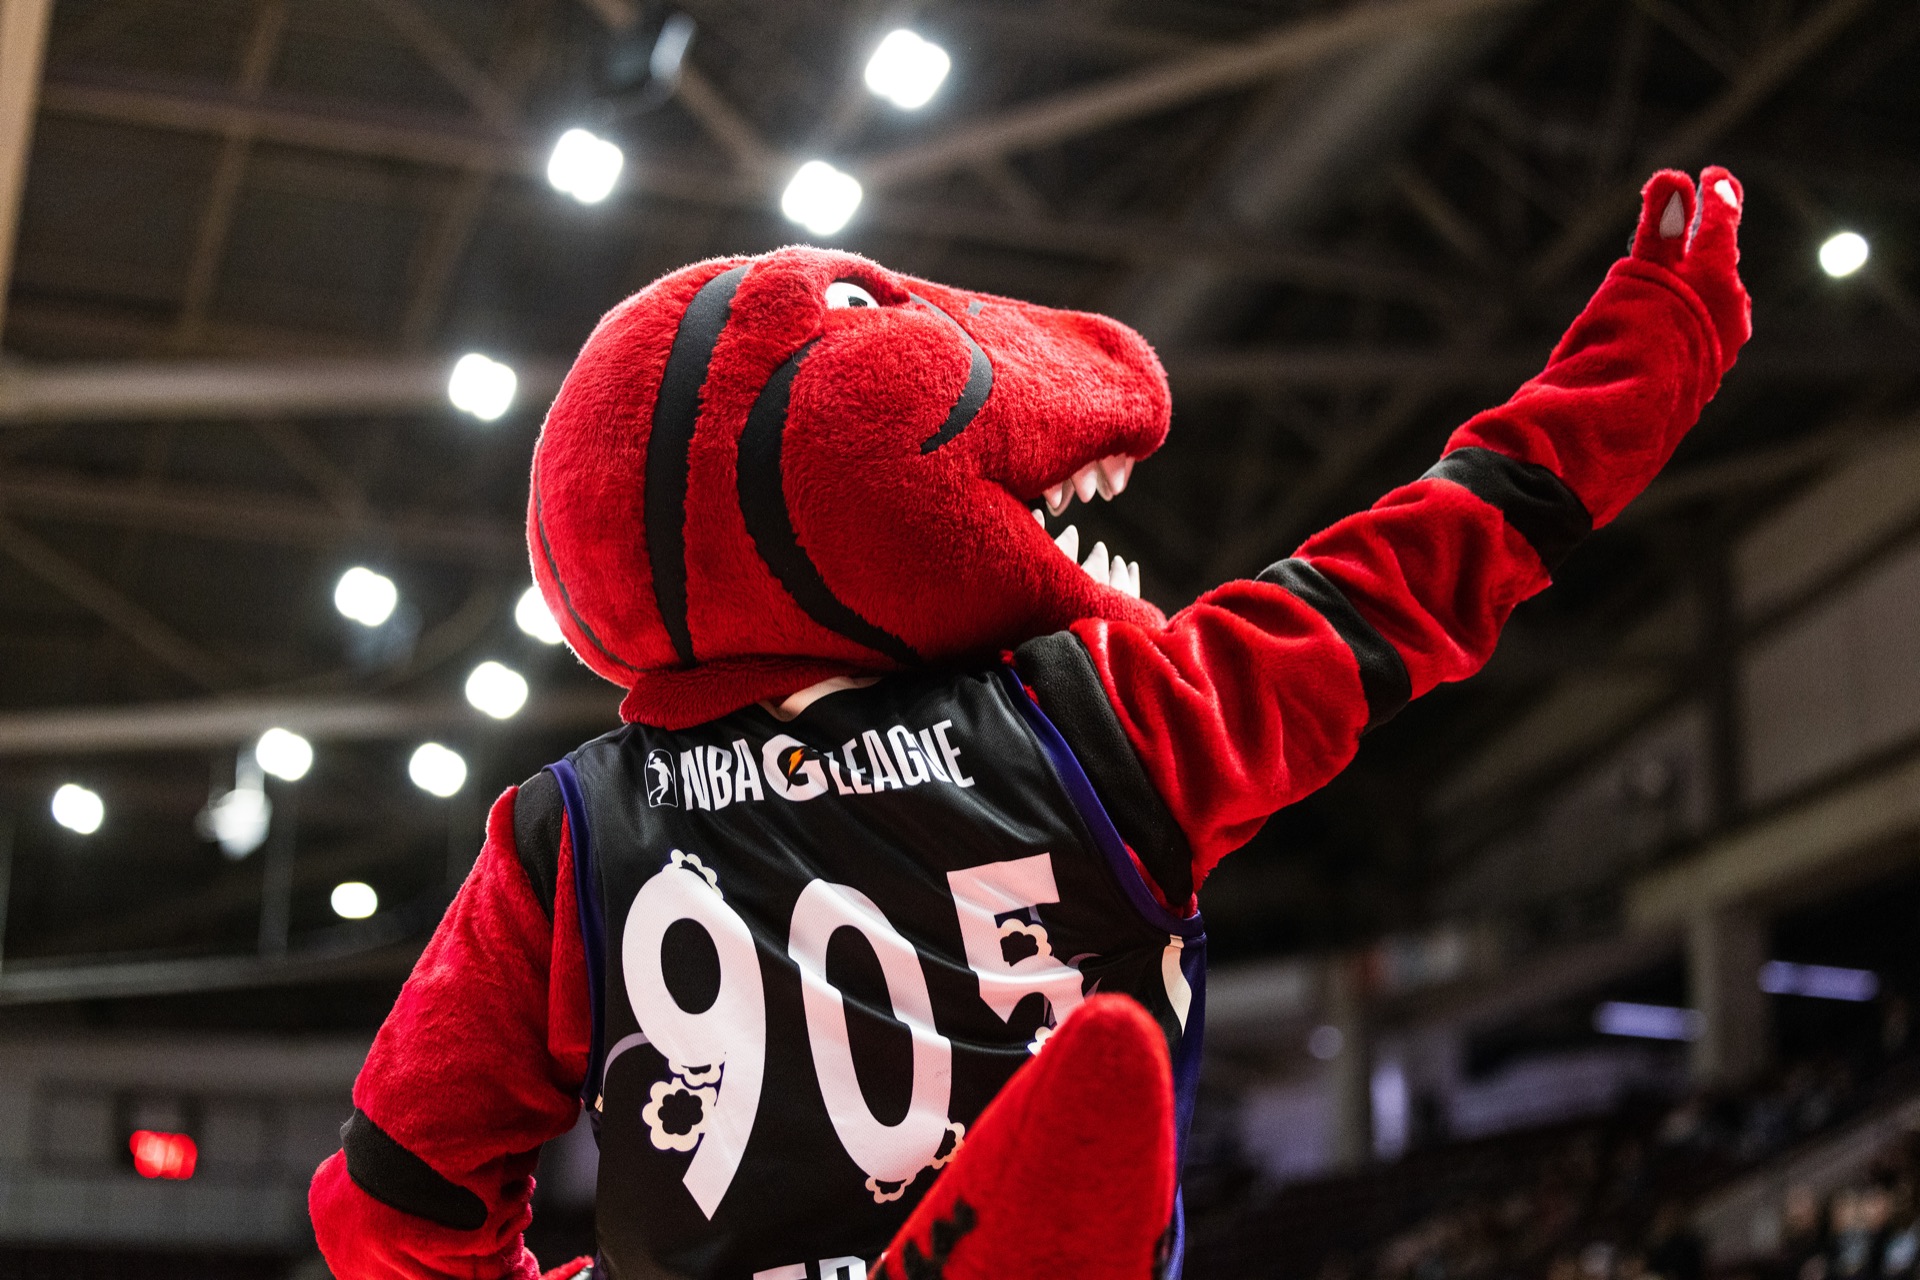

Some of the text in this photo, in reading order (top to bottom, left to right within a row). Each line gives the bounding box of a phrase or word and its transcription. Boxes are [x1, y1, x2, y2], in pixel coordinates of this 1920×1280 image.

[681, 719, 975, 811] NBA G LEAGUE
[621, 853, 1086, 1221] 905
